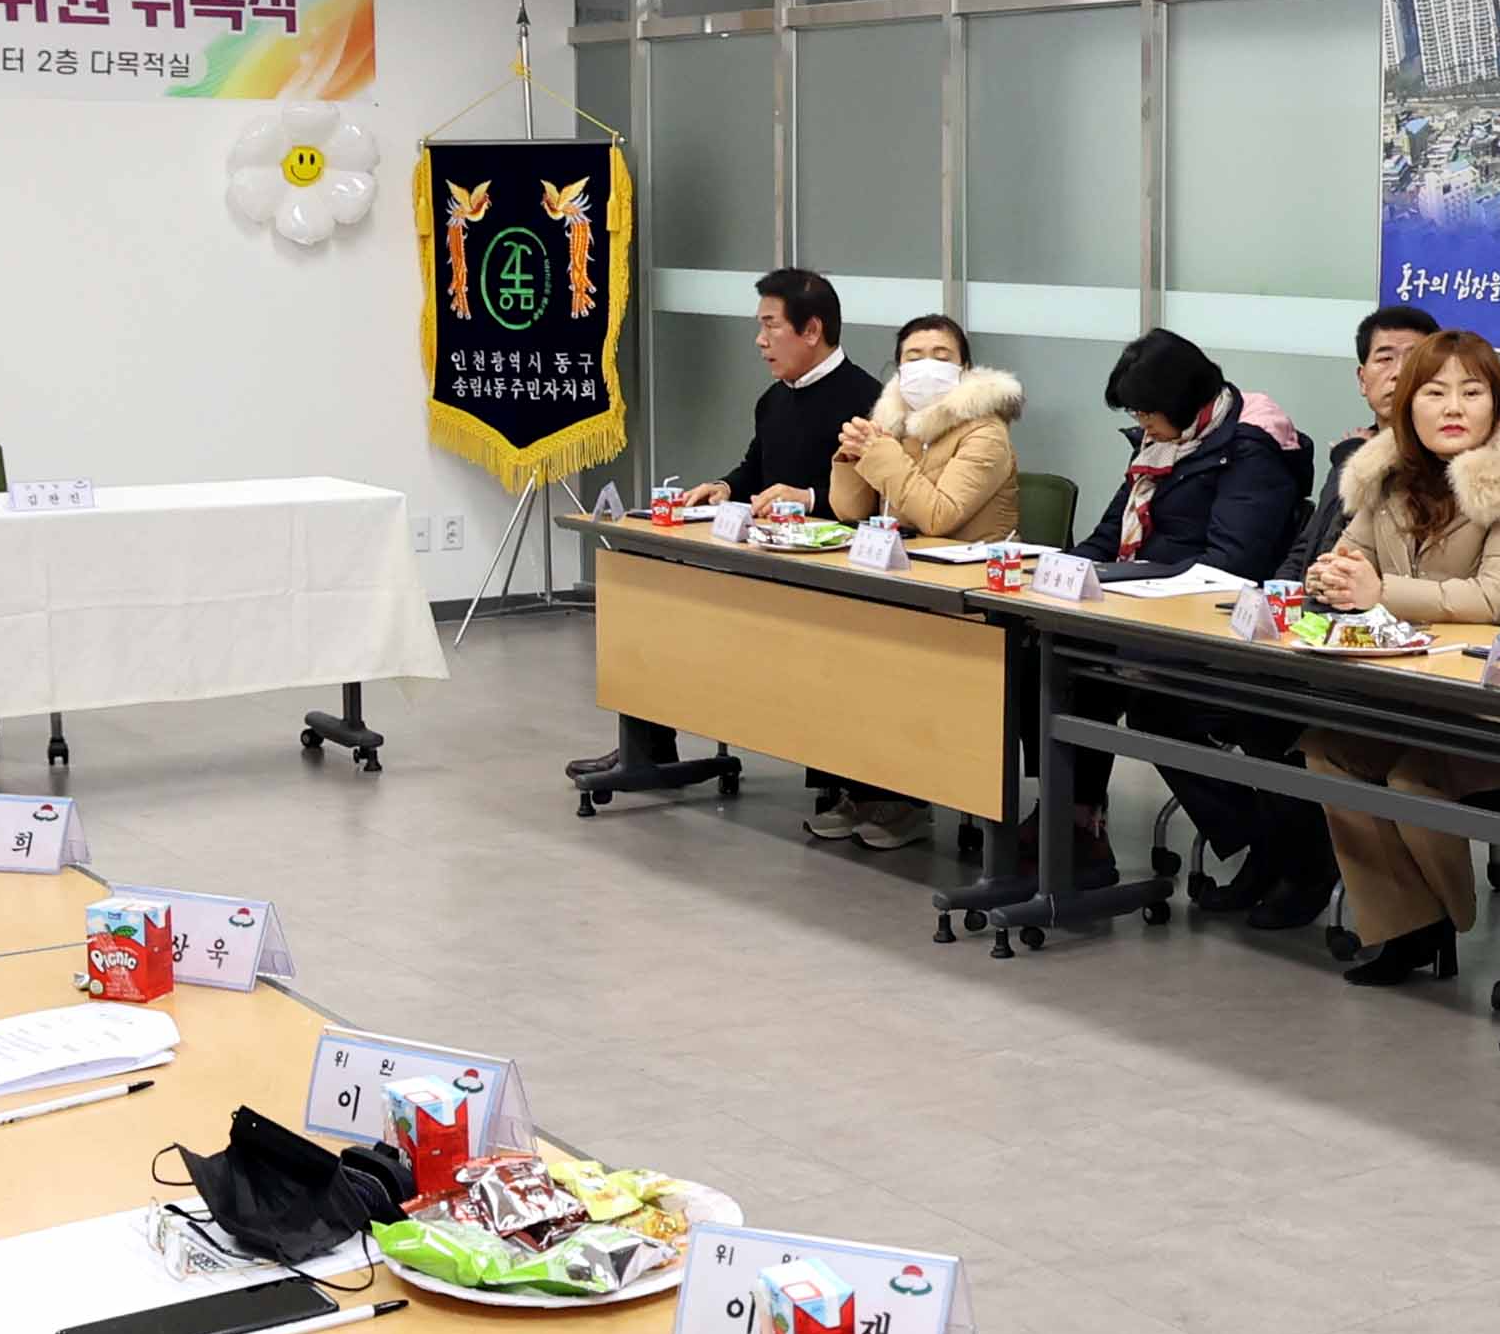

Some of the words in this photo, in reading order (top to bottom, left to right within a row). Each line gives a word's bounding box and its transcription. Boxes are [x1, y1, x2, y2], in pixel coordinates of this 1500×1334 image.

[37, 48, 79, 75] 2층
[90, 50, 190, 78] 다목적실
[1396, 262, 1448, 303] 동구의
[90, 949, 138, 974] Picnic
